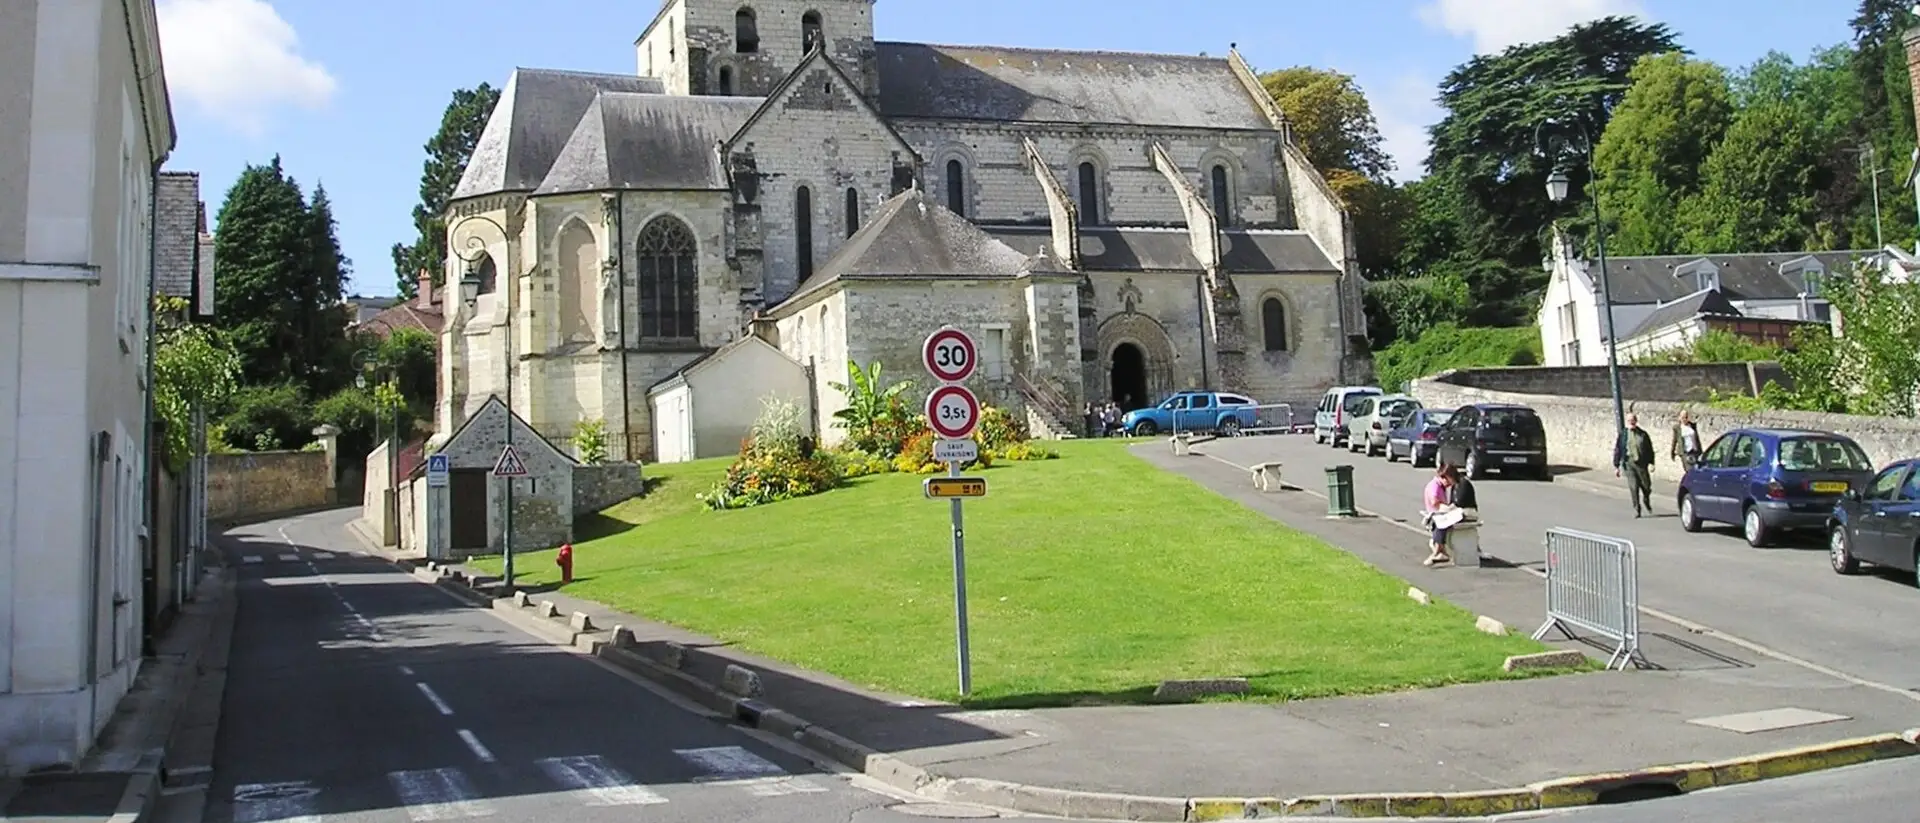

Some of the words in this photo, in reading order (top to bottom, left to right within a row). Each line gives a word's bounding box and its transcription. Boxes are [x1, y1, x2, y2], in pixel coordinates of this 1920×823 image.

[937, 345, 966, 367] 30
[942, 405, 966, 421] 3,5t
[936, 450, 975, 458] LIVRAISONS
